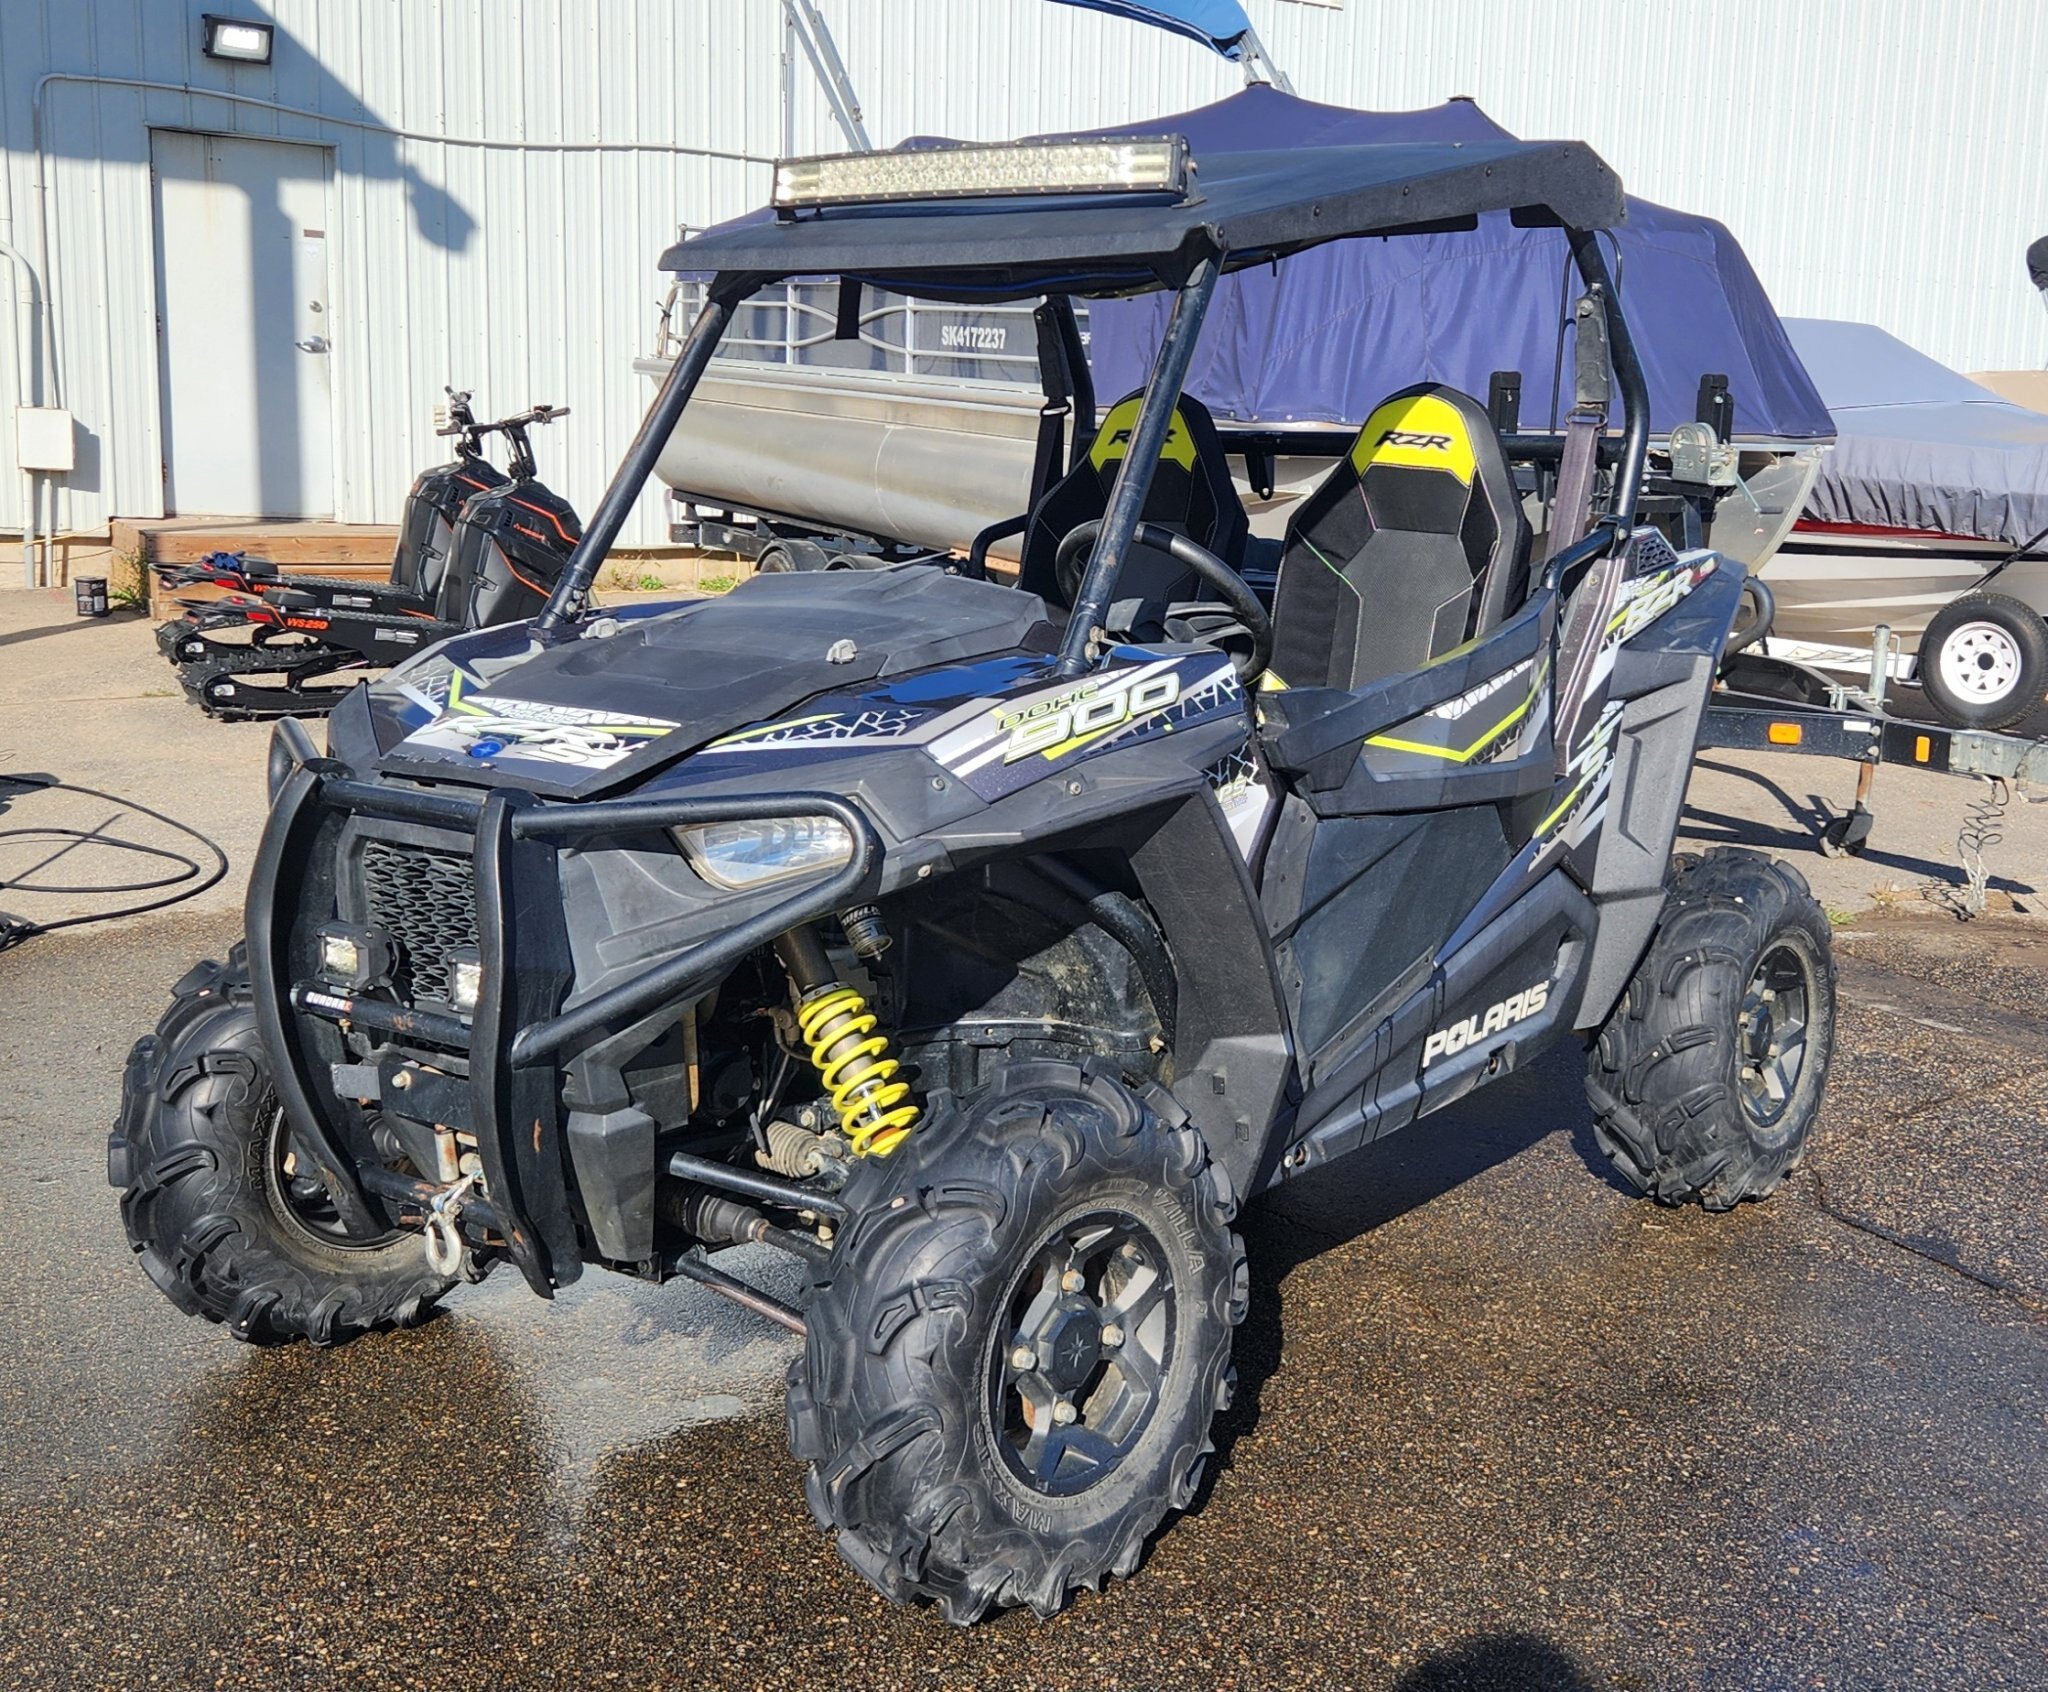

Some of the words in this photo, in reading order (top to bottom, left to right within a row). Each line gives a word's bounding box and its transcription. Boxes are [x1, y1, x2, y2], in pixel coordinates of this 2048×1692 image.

[941, 325, 1006, 349] SK4172237
[1374, 430, 1452, 451] RZR
[1622, 567, 1693, 637] RZR
[501, 709, 579, 724] POLARIS
[997, 683, 1099, 733] DOHC
[1003, 672, 1180, 767] 900
[1422, 980, 1550, 1068] POLARIS
